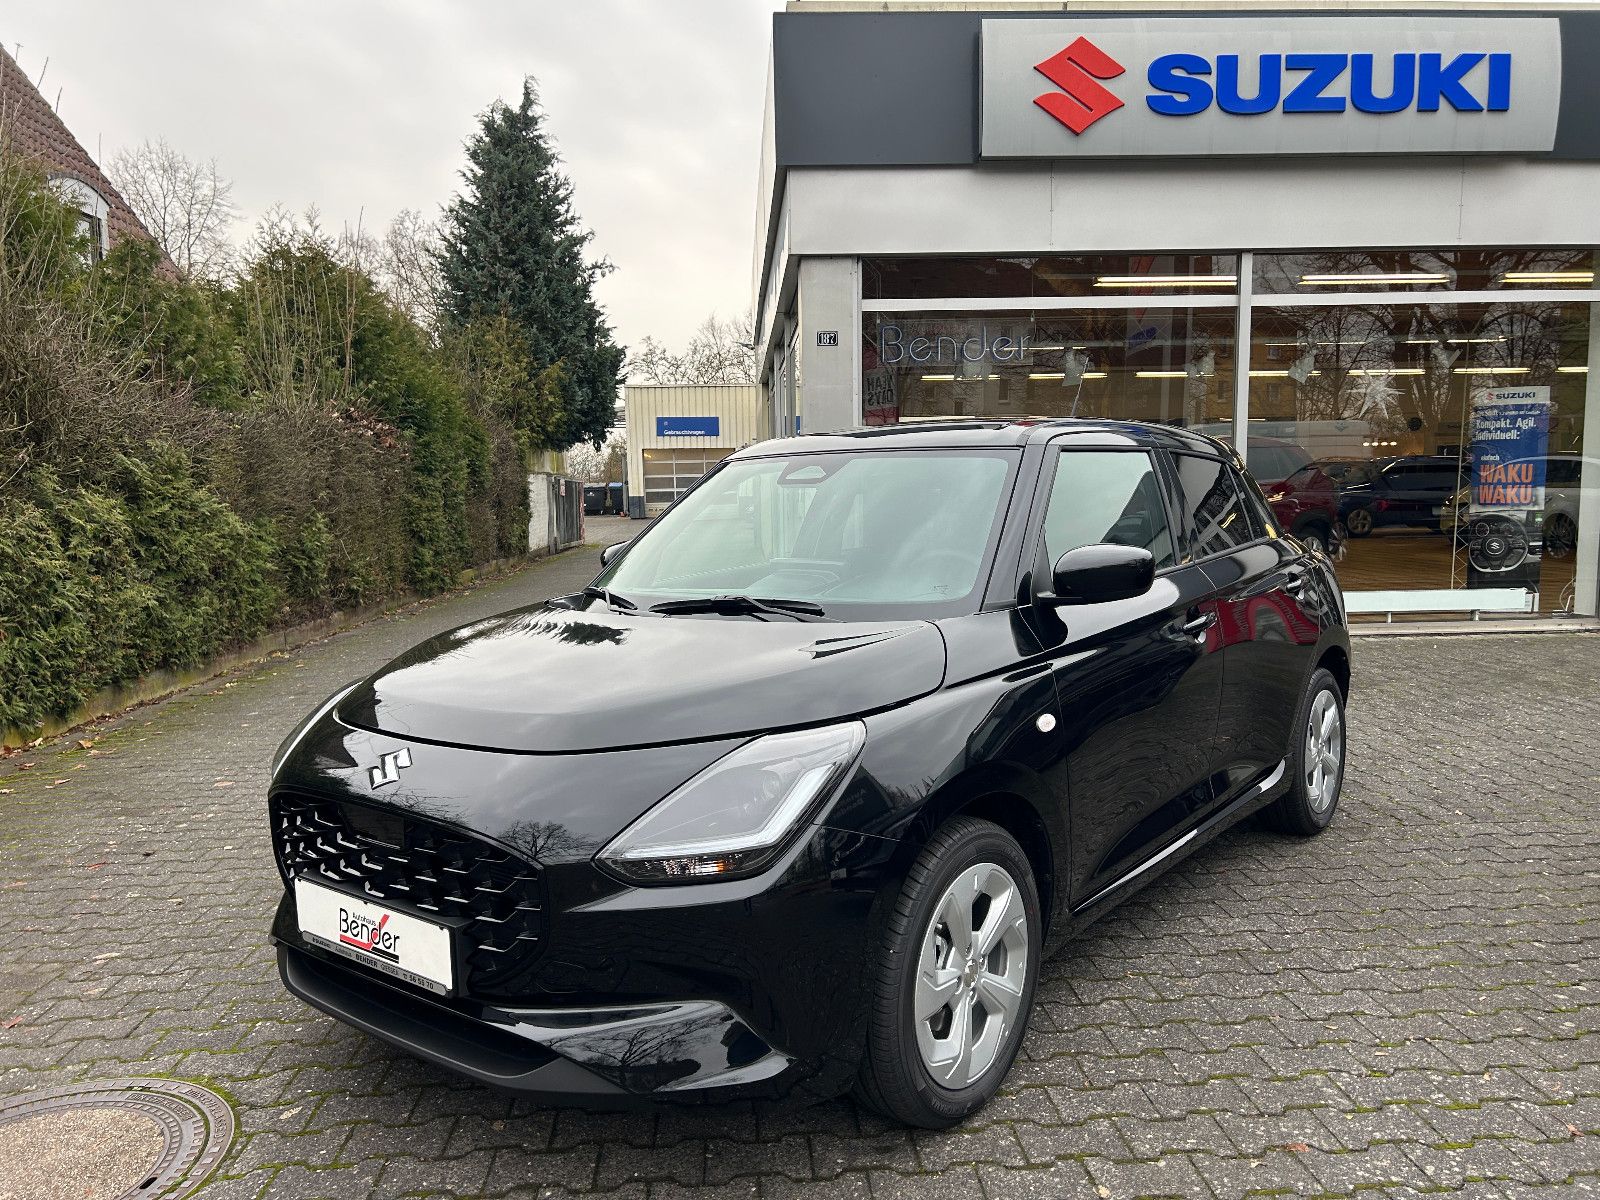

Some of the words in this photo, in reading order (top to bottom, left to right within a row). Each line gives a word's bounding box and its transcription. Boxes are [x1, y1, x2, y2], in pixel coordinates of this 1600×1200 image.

[1145, 53, 1512, 116] SUZUKI
[819, 333, 835, 345] 187
[881, 325, 1031, 363] Bender
[1495, 391, 1536, 400] SUZUKI
[1476, 418, 1513, 430] Kompakt.
[1516, 417, 1537, 430] Agil.
[1480, 463, 1533, 483] WAKU
[339, 908, 400, 952] Bender
[355, 953, 378, 968] BENDER
